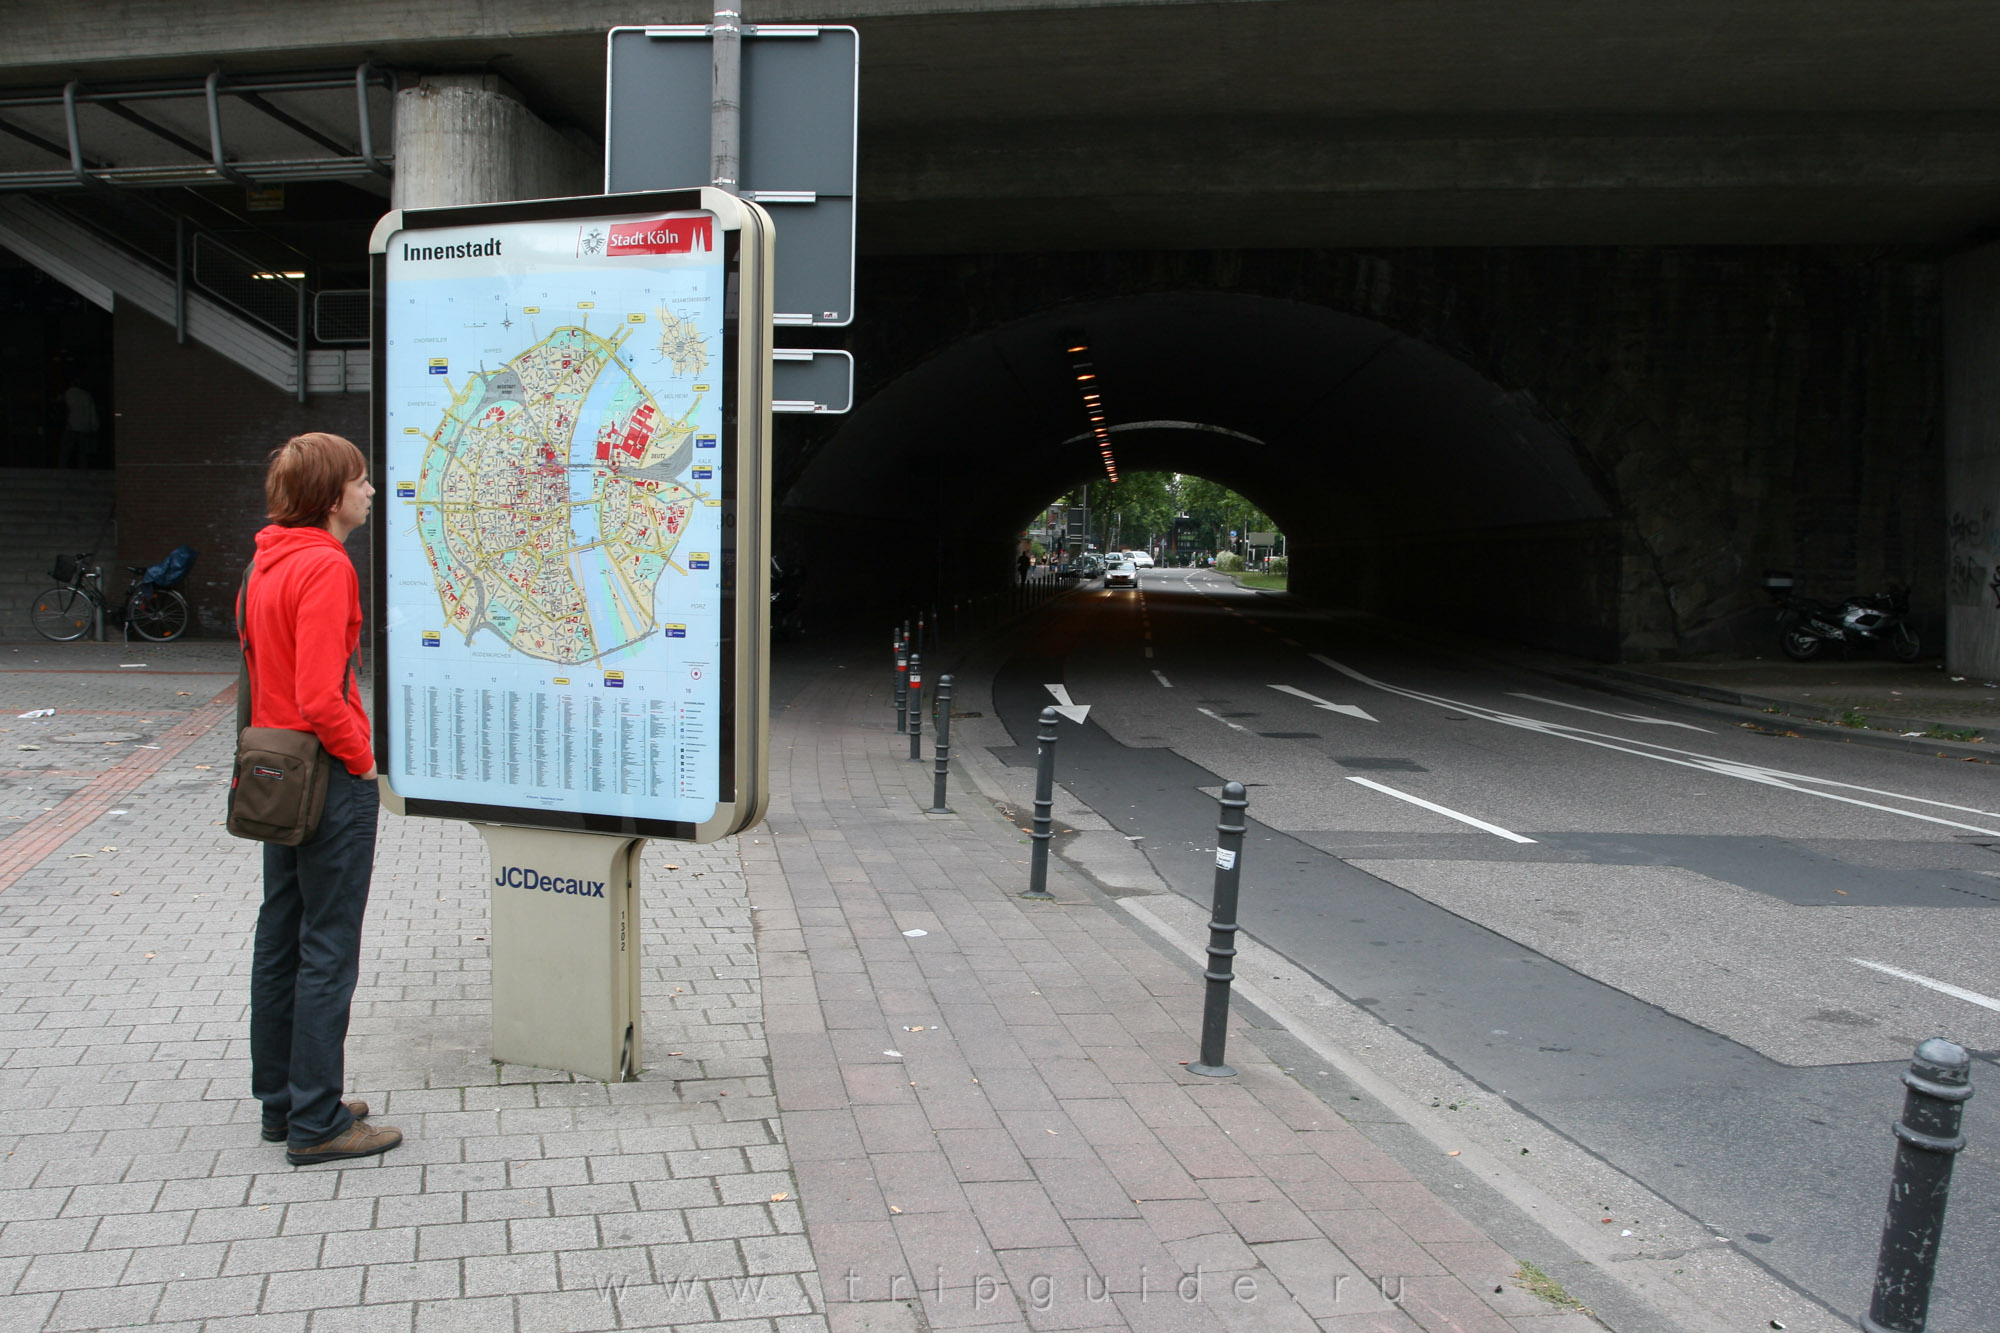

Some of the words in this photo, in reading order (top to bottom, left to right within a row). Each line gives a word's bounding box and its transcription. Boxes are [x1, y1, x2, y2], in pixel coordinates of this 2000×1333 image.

[403, 238, 502, 261] Innenstadt
[610, 231, 645, 247] Stadt
[647, 229, 679, 246] Köln
[495, 866, 605, 898] JCDecaux
